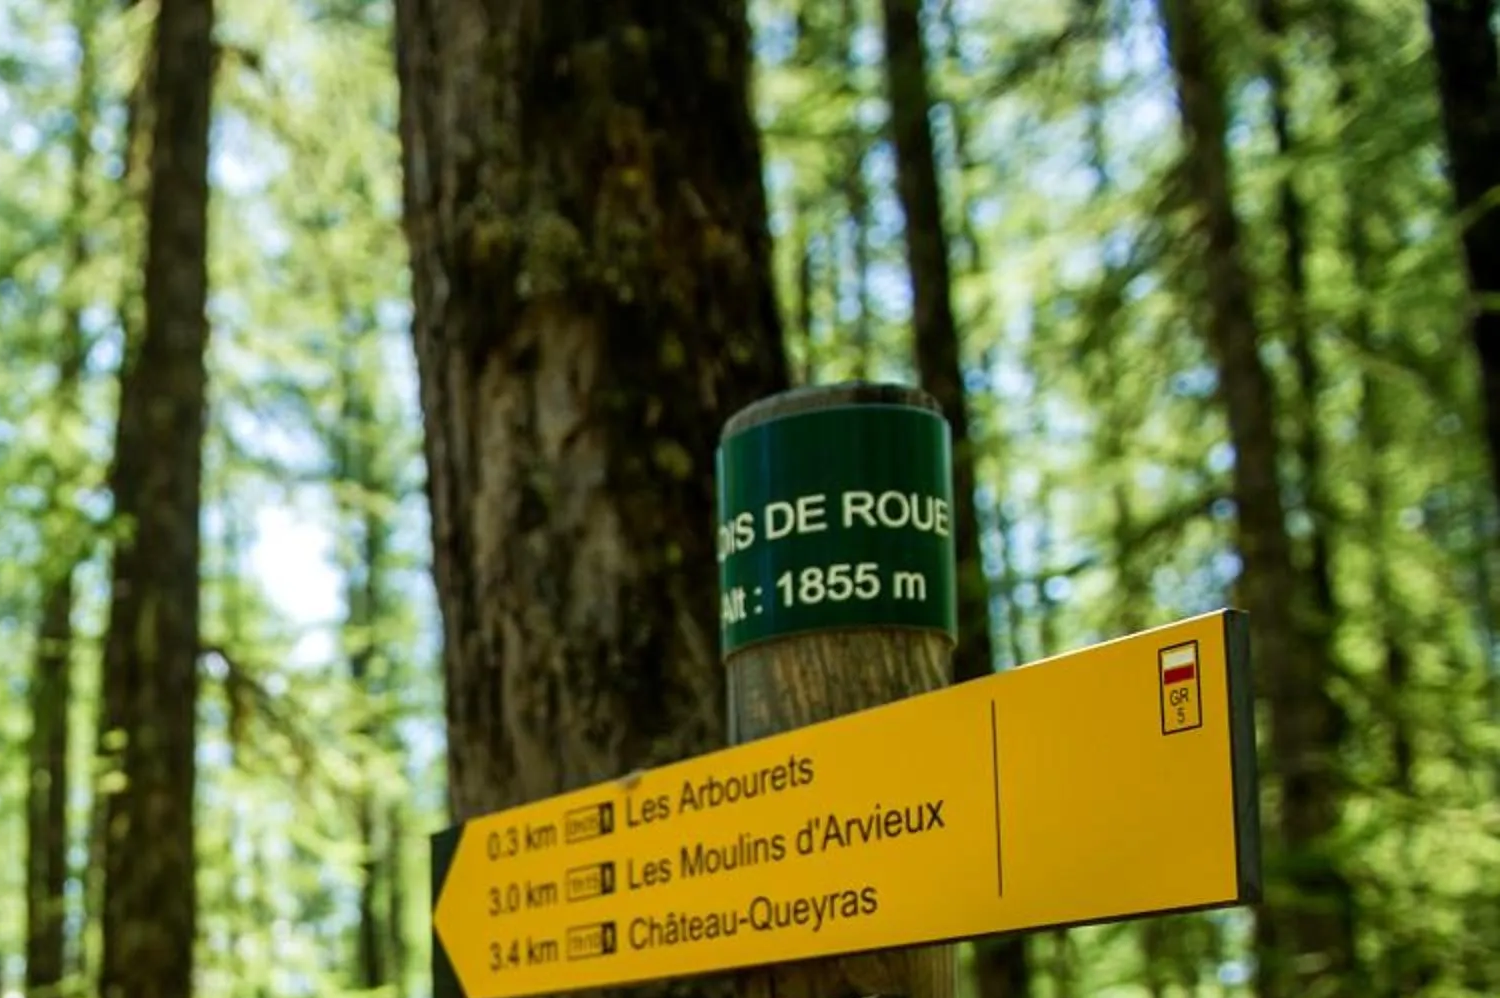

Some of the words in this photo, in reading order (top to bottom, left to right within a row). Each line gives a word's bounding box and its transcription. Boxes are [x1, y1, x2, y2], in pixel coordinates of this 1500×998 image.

[717, 511, 755, 562] OIS
[764, 494, 827, 540] DE
[842, 490, 949, 537] ROUE
[776, 562, 881, 608] 1855
[893, 571, 926, 600] m
[1170, 687, 1189, 706] GR
[1177, 707, 1186, 724] 5
[486, 826, 519, 861] 0.3
[525, 823, 557, 851] km
[626, 795, 670, 828] Les
[678, 754, 815, 815] Arbourets
[488, 883, 520, 917] 3.0
[526, 881, 558, 909] km
[627, 857, 672, 891] Les
[680, 831, 786, 880] Moulins
[796, 799, 945, 856] d'Arvieux
[489, 938, 520, 972] 3.4
[527, 935, 558, 964] km
[628, 884, 878, 951] Château-Queyras
